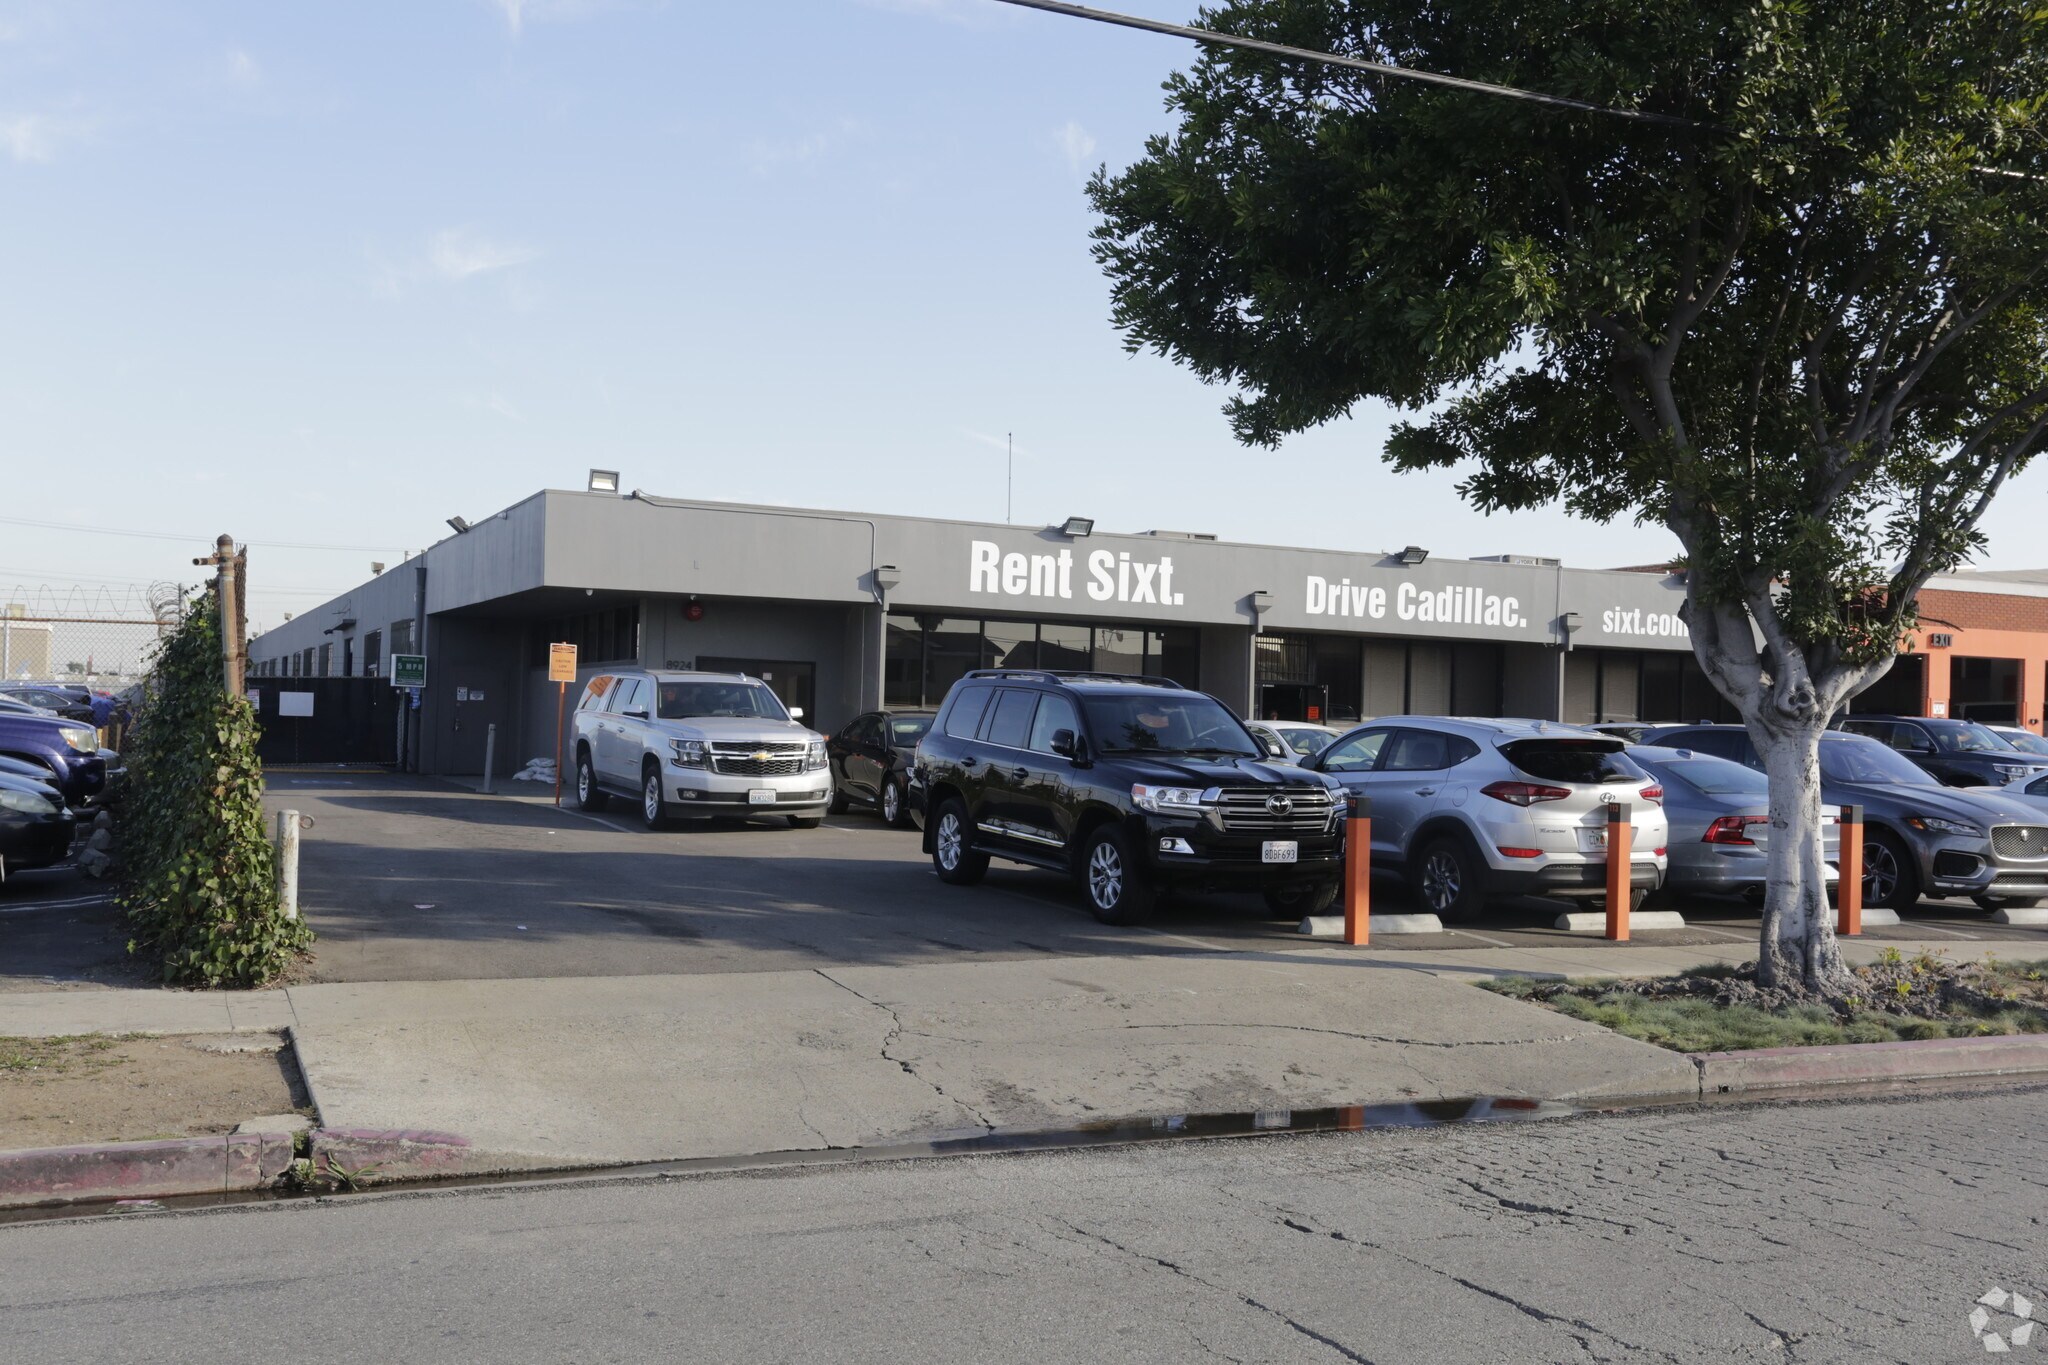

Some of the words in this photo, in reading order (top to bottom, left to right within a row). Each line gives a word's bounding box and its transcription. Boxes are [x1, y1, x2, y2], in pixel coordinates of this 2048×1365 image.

[970, 540, 1073, 599] Rent
[1087, 549, 1184, 606] Sixt.
[1306, 575, 1386, 619] Drive
[1397, 582, 1527, 628] Cadillac.
[1932, 633, 1953, 647] EXIT
[397, 662, 403, 670] 5
[666, 660, 692, 671] 8924
[1264, 849, 1296, 860] 8DBF693
